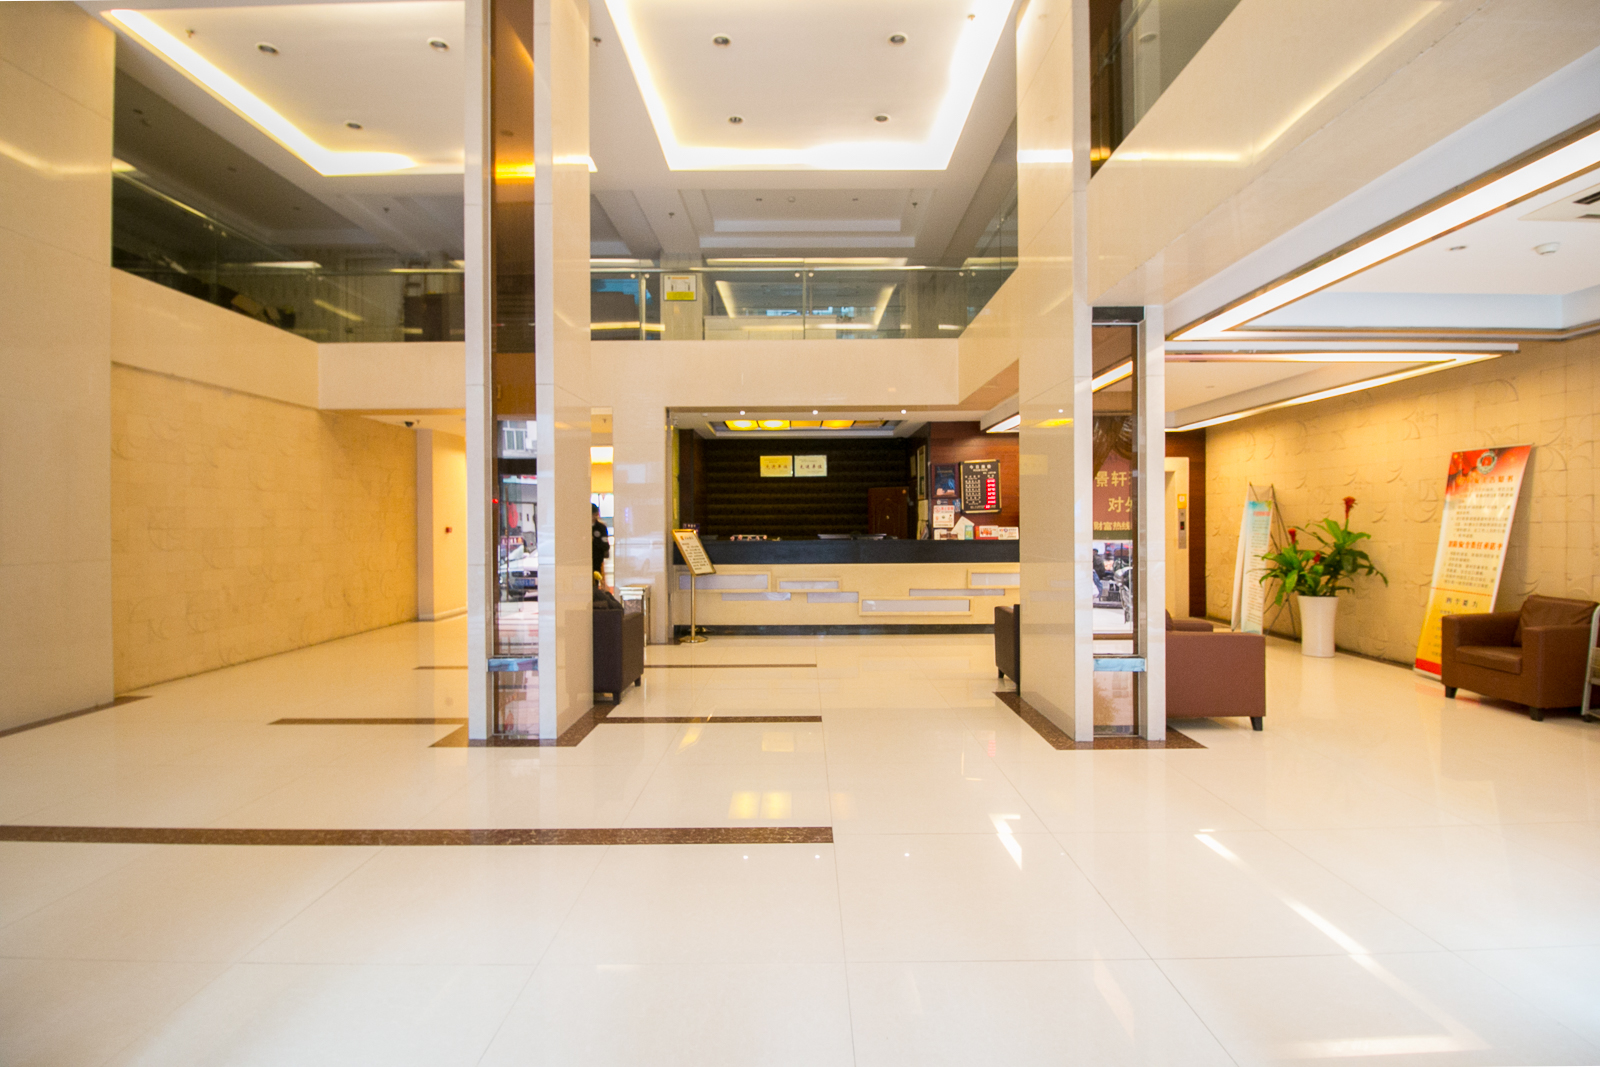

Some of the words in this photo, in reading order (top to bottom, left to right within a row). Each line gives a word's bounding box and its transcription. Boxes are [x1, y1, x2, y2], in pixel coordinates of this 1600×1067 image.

[1094, 470, 1132, 487] 景轩
[1093, 521, 1131, 531] 财富热线
